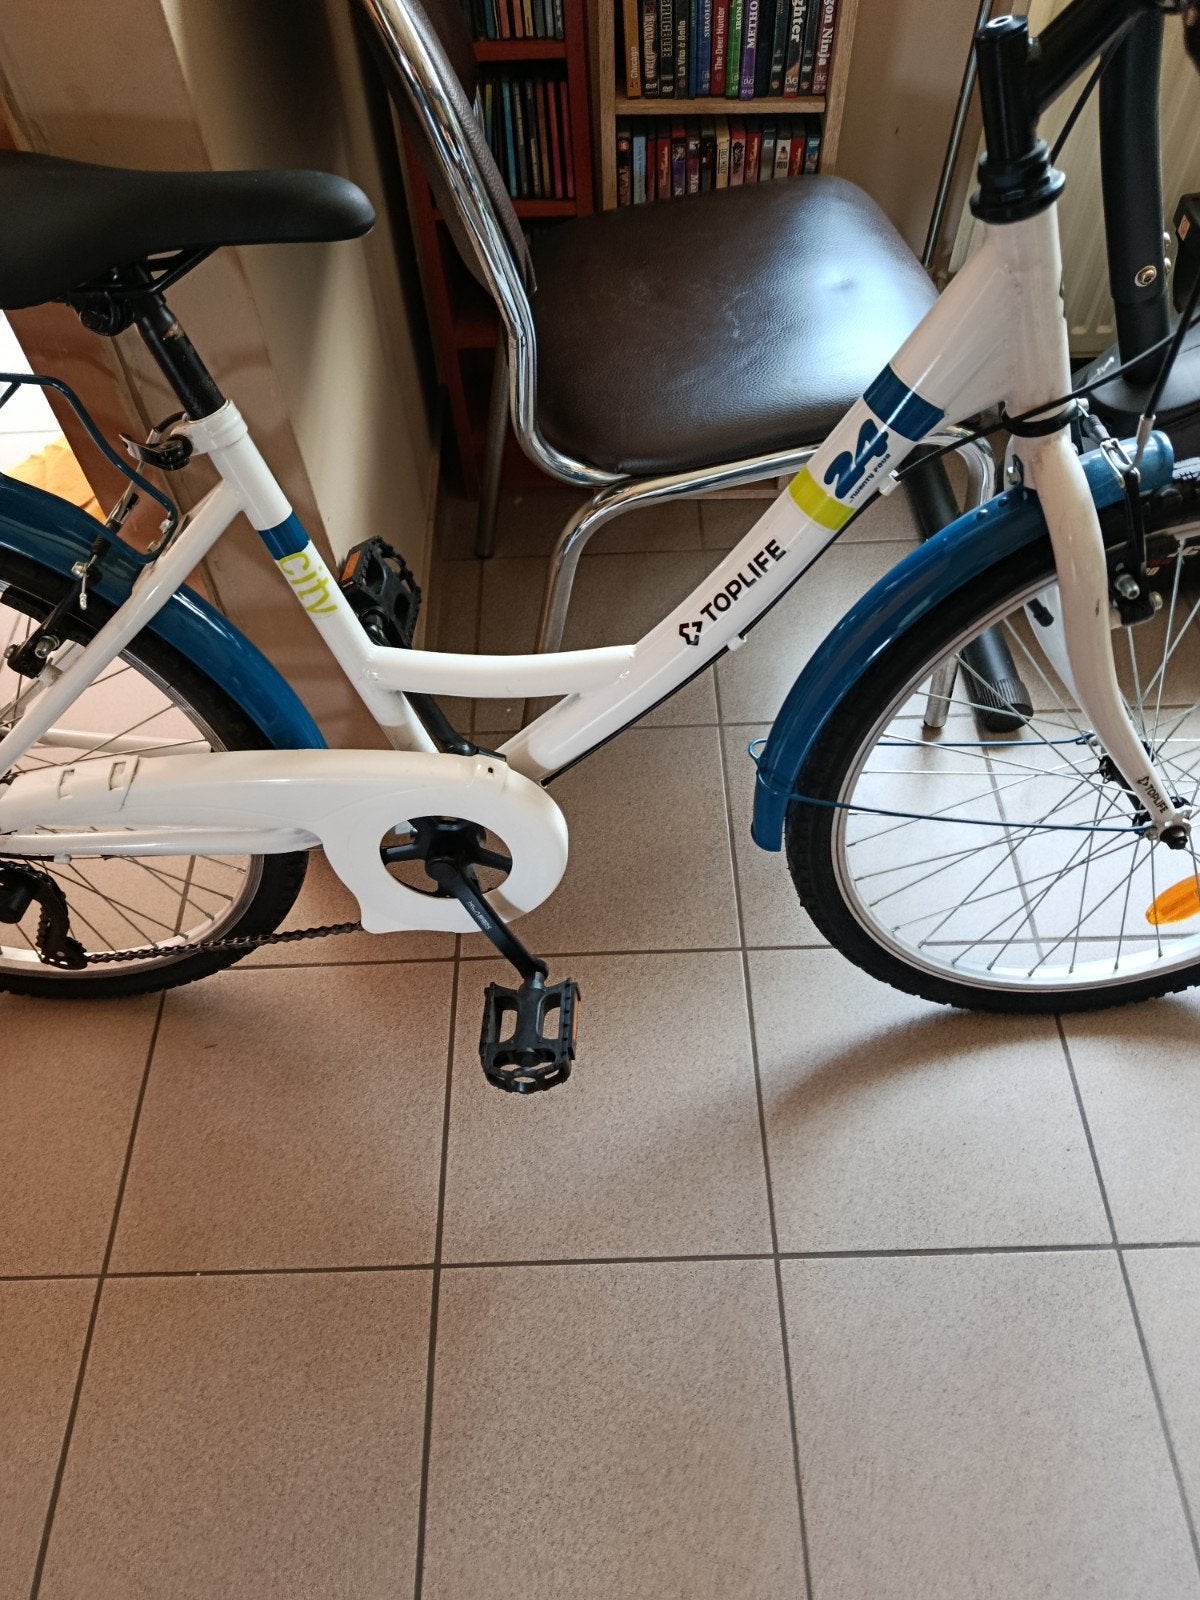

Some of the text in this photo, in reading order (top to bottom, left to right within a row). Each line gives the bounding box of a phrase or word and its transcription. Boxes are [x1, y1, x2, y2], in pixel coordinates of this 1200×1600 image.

[677, 20, 686, 40] Bella
[735, 6, 743, 30] IRON
[661, 38, 672, 57] LEE
[714, 7, 725, 71] The Deer Hunter
[817, 27, 833, 66] Ninja
[630, 46, 639, 79] Chicago
[677, 50, 686, 65] Vita
[677, 67, 686, 76] La
[824, 418, 889, 499] 24
[279, 552, 338, 614] city
[700, 539, 787, 622] TOPLIFE
[1145, 784, 1169, 814] TOPLIFE
